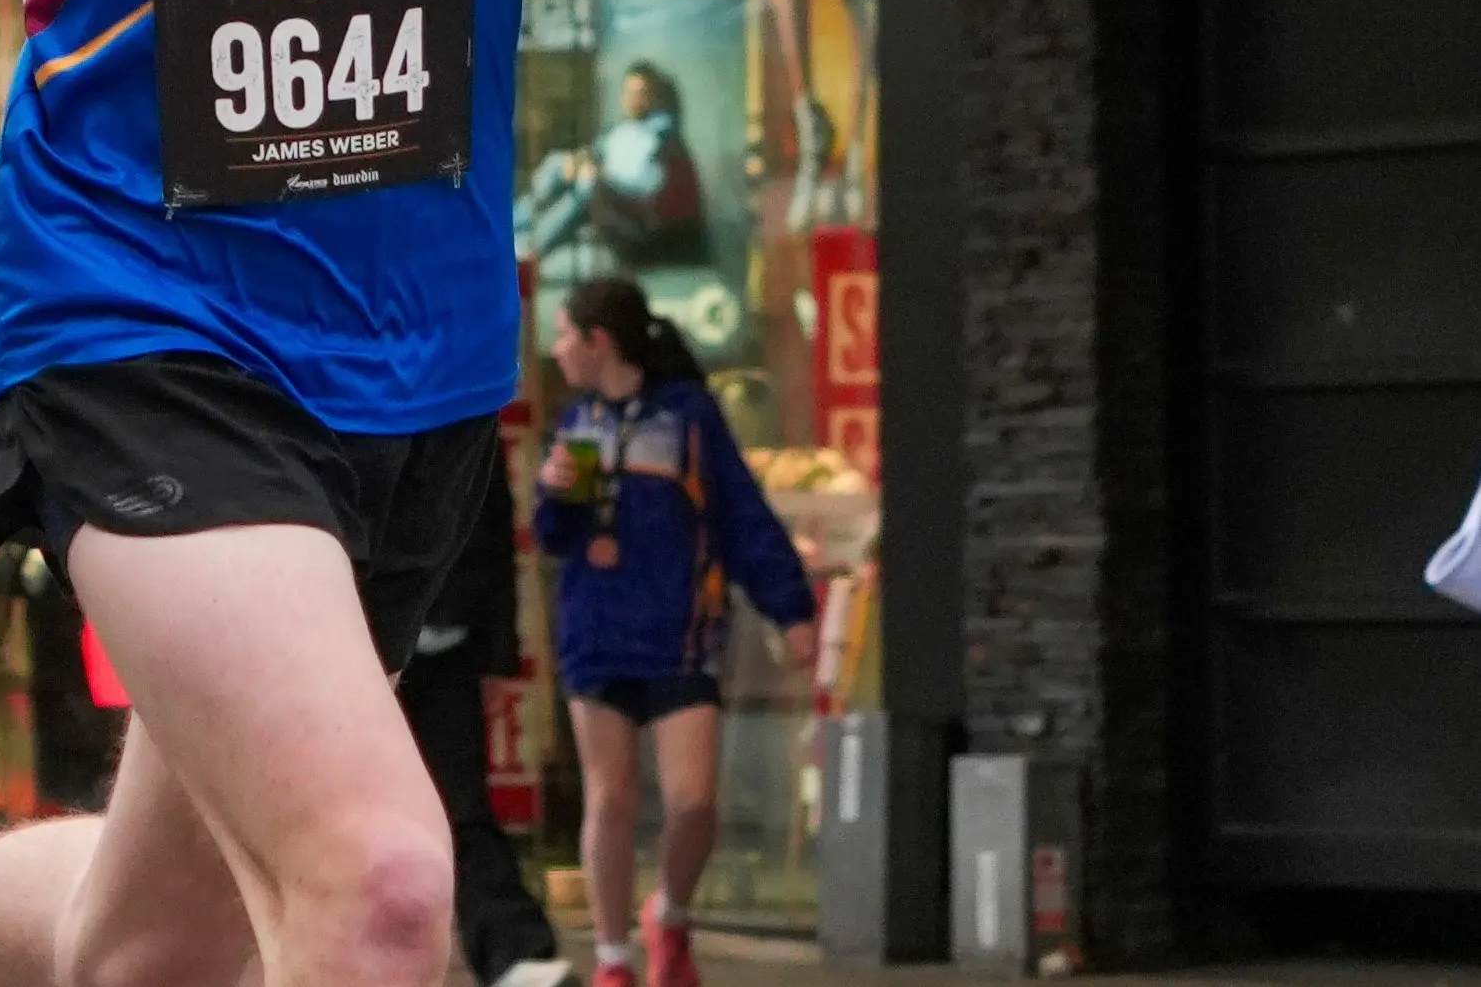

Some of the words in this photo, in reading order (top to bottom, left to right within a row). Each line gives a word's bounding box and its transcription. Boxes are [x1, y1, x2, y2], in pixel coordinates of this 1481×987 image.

[211, 7, 430, 133] 9644
[251, 139, 325, 162] JAMES
[329, 130, 400, 155] WEBER
